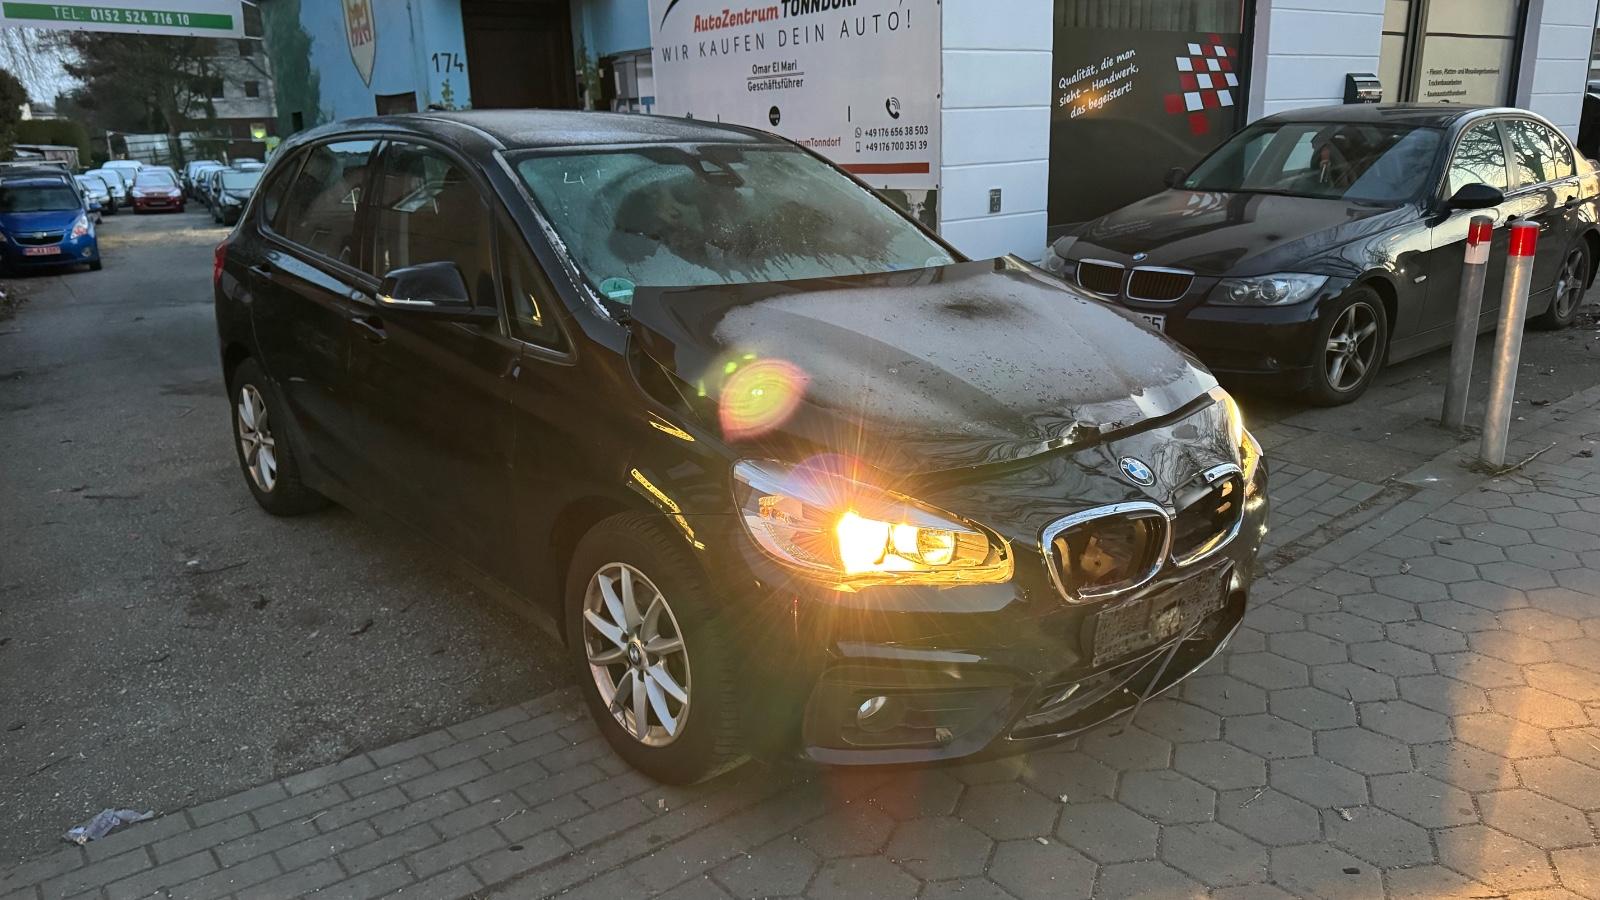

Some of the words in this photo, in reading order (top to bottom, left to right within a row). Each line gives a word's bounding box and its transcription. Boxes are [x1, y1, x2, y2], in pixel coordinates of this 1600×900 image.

[52, 6, 84, 20] TEL:
[91, 10, 120, 22] 0152
[126, 11, 148, 23] 524
[153, 12, 173, 24] 716
[177, 14, 190, 26] 10
[694, 6, 778, 32] AutoZentrum
[662, 44, 689, 62] WIR
[699, 32, 765, 58] KAUFEN
[778, 23, 824, 47] DEIN
[840, 9, 910, 39] AUTO!
[431, 52, 464, 72] 174
[752, 63, 771, 75] Omar
[772, 61, 780, 73] El
[781, 59, 797, 71] Mari
[1058, 65, 1098, 89] Qualität,
[1100, 56, 1114, 71] die
[1116, 49, 1136, 64] man
[747, 78, 804, 92] Geschäftsführer
[1059, 88, 1081, 107] sieht
[1092, 62, 1139, 92] Handwerk,
[1070, 104, 1086, 119] das
[1088, 80, 1132, 110] begeistert!
[865, 128, 877, 138] +49
[878, 127, 889, 138] 176
[890, 127, 904, 137] 656
[905, 126, 914, 136] 38
[915, 125, 929, 136] 503
[866, 142, 878, 152] +49
[879, 142, 890, 152] 176
[891, 141, 905, 151] 700
[906, 141, 917, 151] 351
[918, 140, 928, 150] 39
